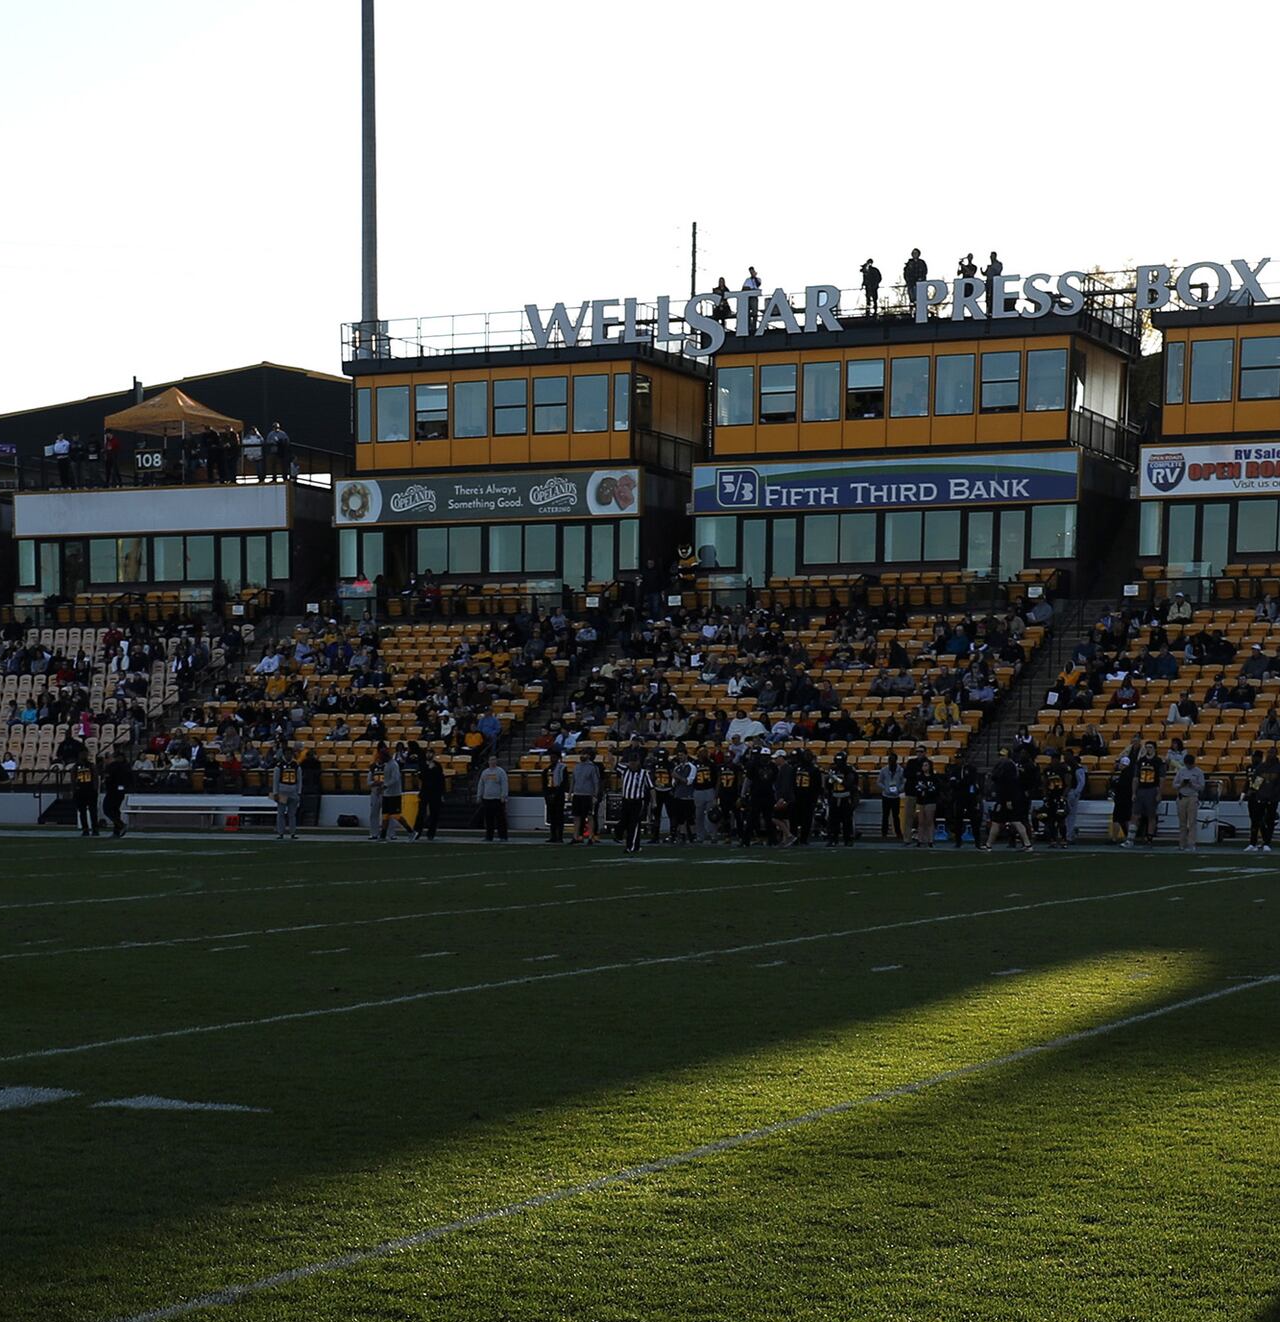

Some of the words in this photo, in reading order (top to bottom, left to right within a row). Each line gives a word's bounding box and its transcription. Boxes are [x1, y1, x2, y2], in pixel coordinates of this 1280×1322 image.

[524, 284, 846, 357] WELLSTAR
[915, 270, 1086, 323] PRESS
[1136, 257, 1271, 310] BOX
[136, 453, 162, 468] 108
[1235, 449, 1252, 460] RV
[1152, 467, 1181, 484] RV
[1188, 462, 1241, 481] OPEN
[454, 484, 484, 496] There's
[485, 484, 517, 496] Always
[765, 486, 839, 506] FIFTH
[850, 482, 938, 504] THIRD
[948, 478, 1030, 501] BANK
[1233, 480, 1255, 489] Visit
[448, 499, 495, 511] Something
[497, 496, 524, 508] Good.
